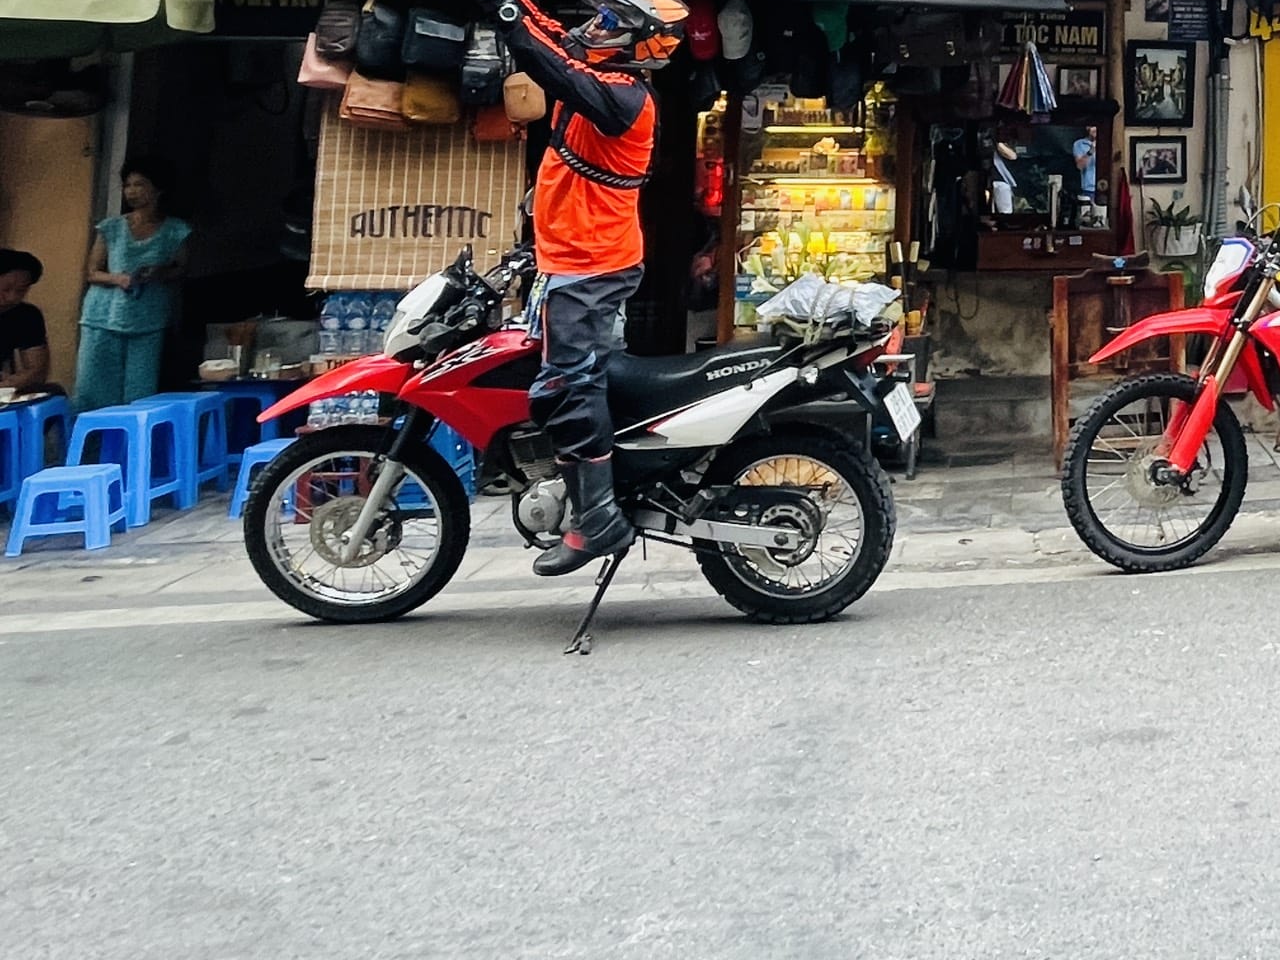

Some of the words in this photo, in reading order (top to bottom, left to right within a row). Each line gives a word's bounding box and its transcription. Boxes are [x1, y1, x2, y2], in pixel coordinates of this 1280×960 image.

[1055, 25, 1098, 46] NAM
[350, 204, 493, 238] AUTHENTIC
[706, 358, 771, 381] HONDA
